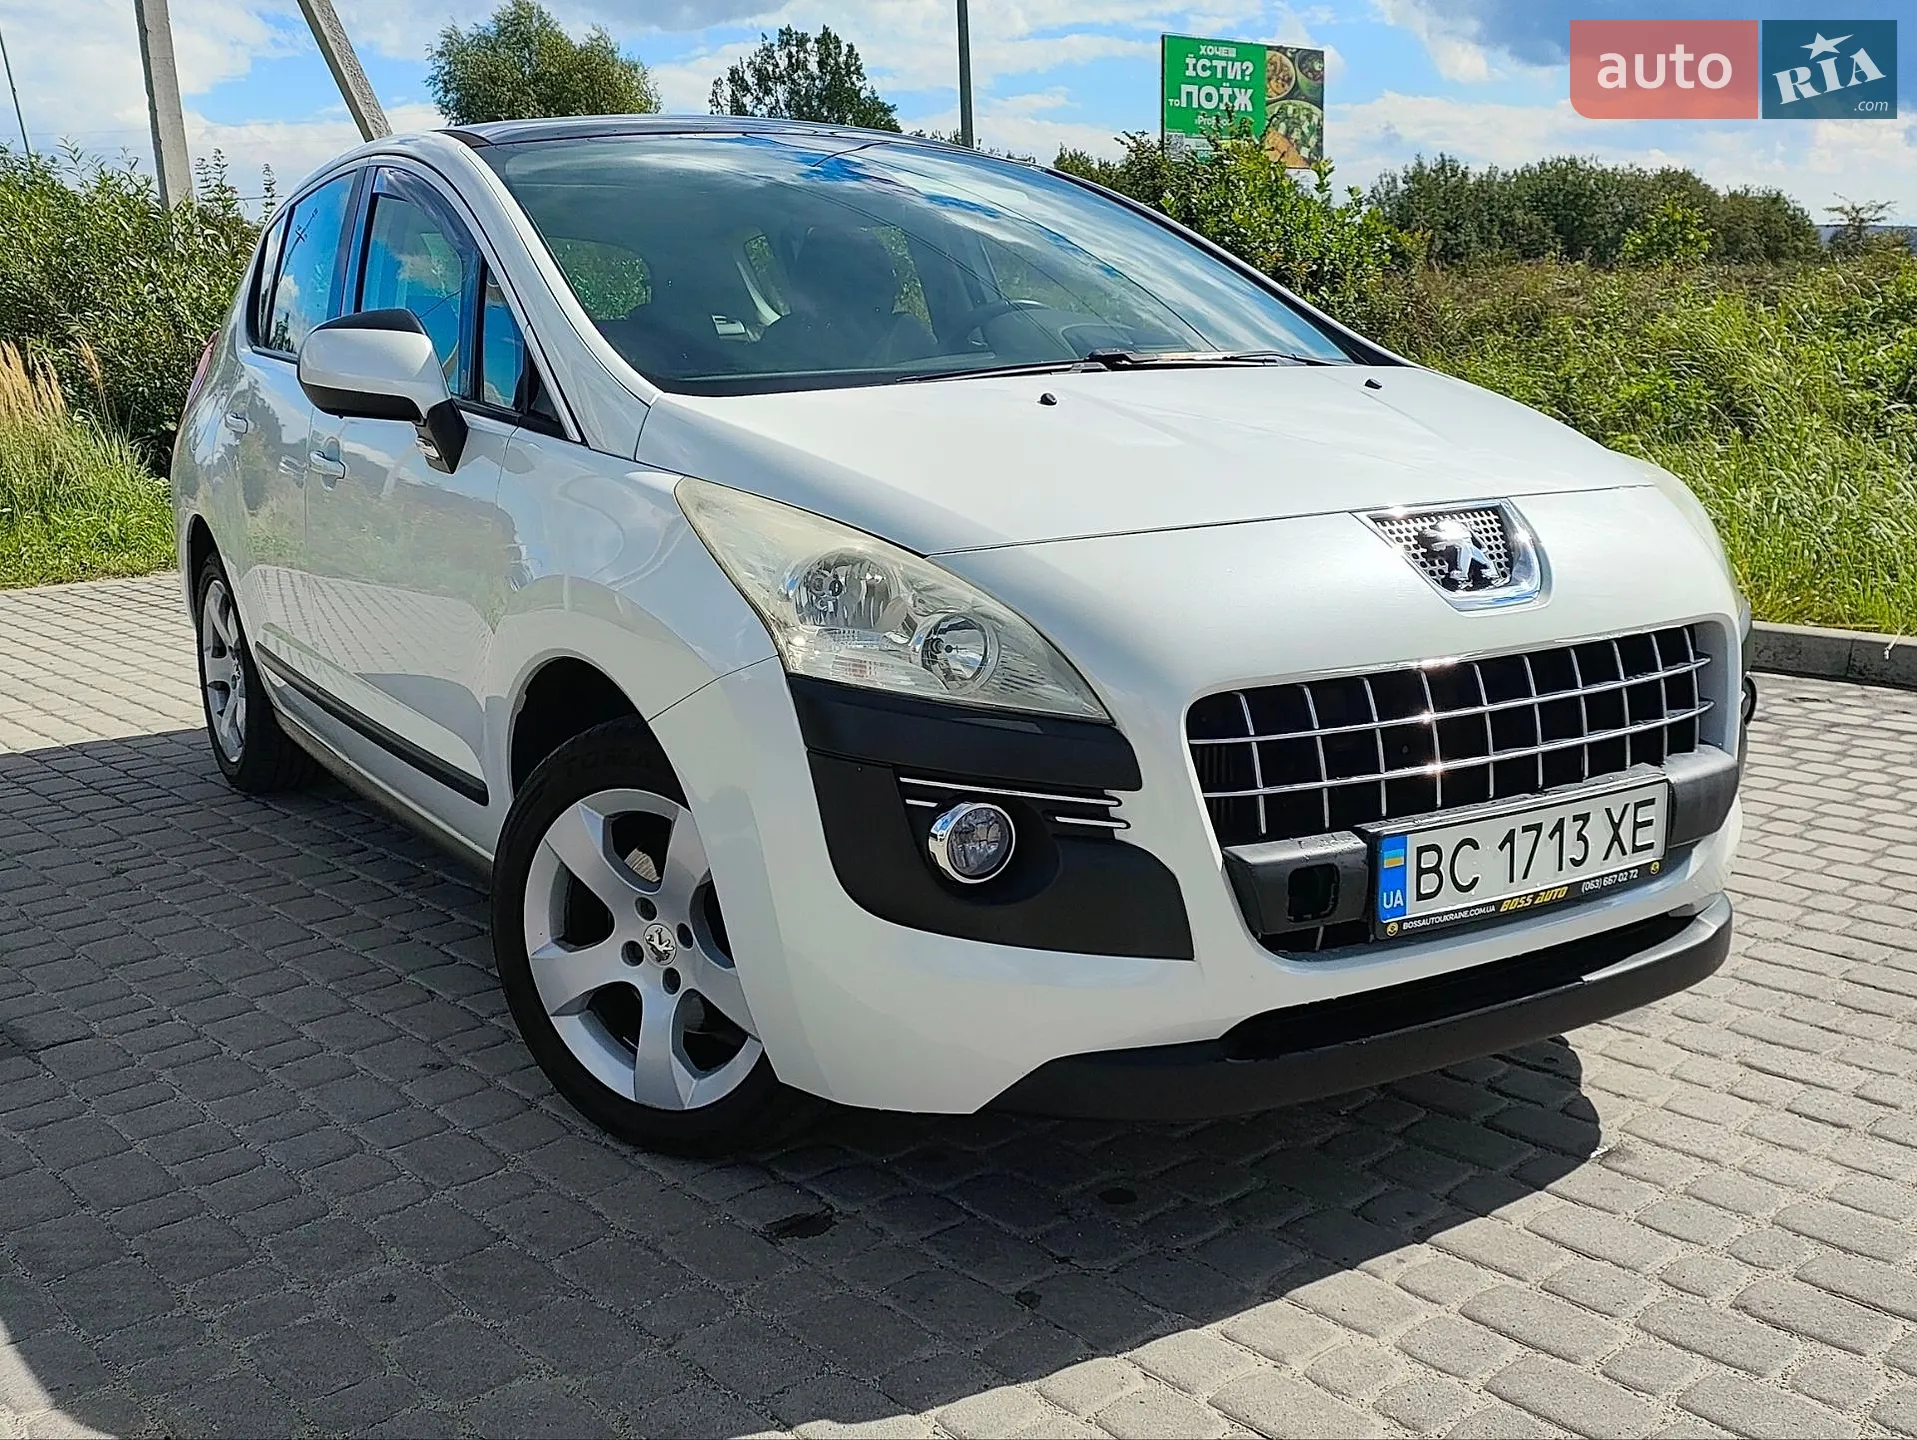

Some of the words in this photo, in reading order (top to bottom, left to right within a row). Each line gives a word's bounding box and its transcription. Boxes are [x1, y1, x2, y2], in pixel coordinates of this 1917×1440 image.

[1200, 45, 1237, 58] ХОЧЕШ
[1185, 54, 1255, 82] ЇСТИ?
[1180, 83, 1254, 112] ПОЇЖ
[1415, 838, 1480, 902] BC
[1499, 811, 1592, 884] 1713
[1602, 797, 1657, 861] XE
[1629, 869, 1639, 879] 72
[1383, 889, 1404, 909] UA
[1499, 895, 1534, 912] BOSS
[1402, 904, 1496, 930] BOSSAUTOUKRAINE.COM.UA
